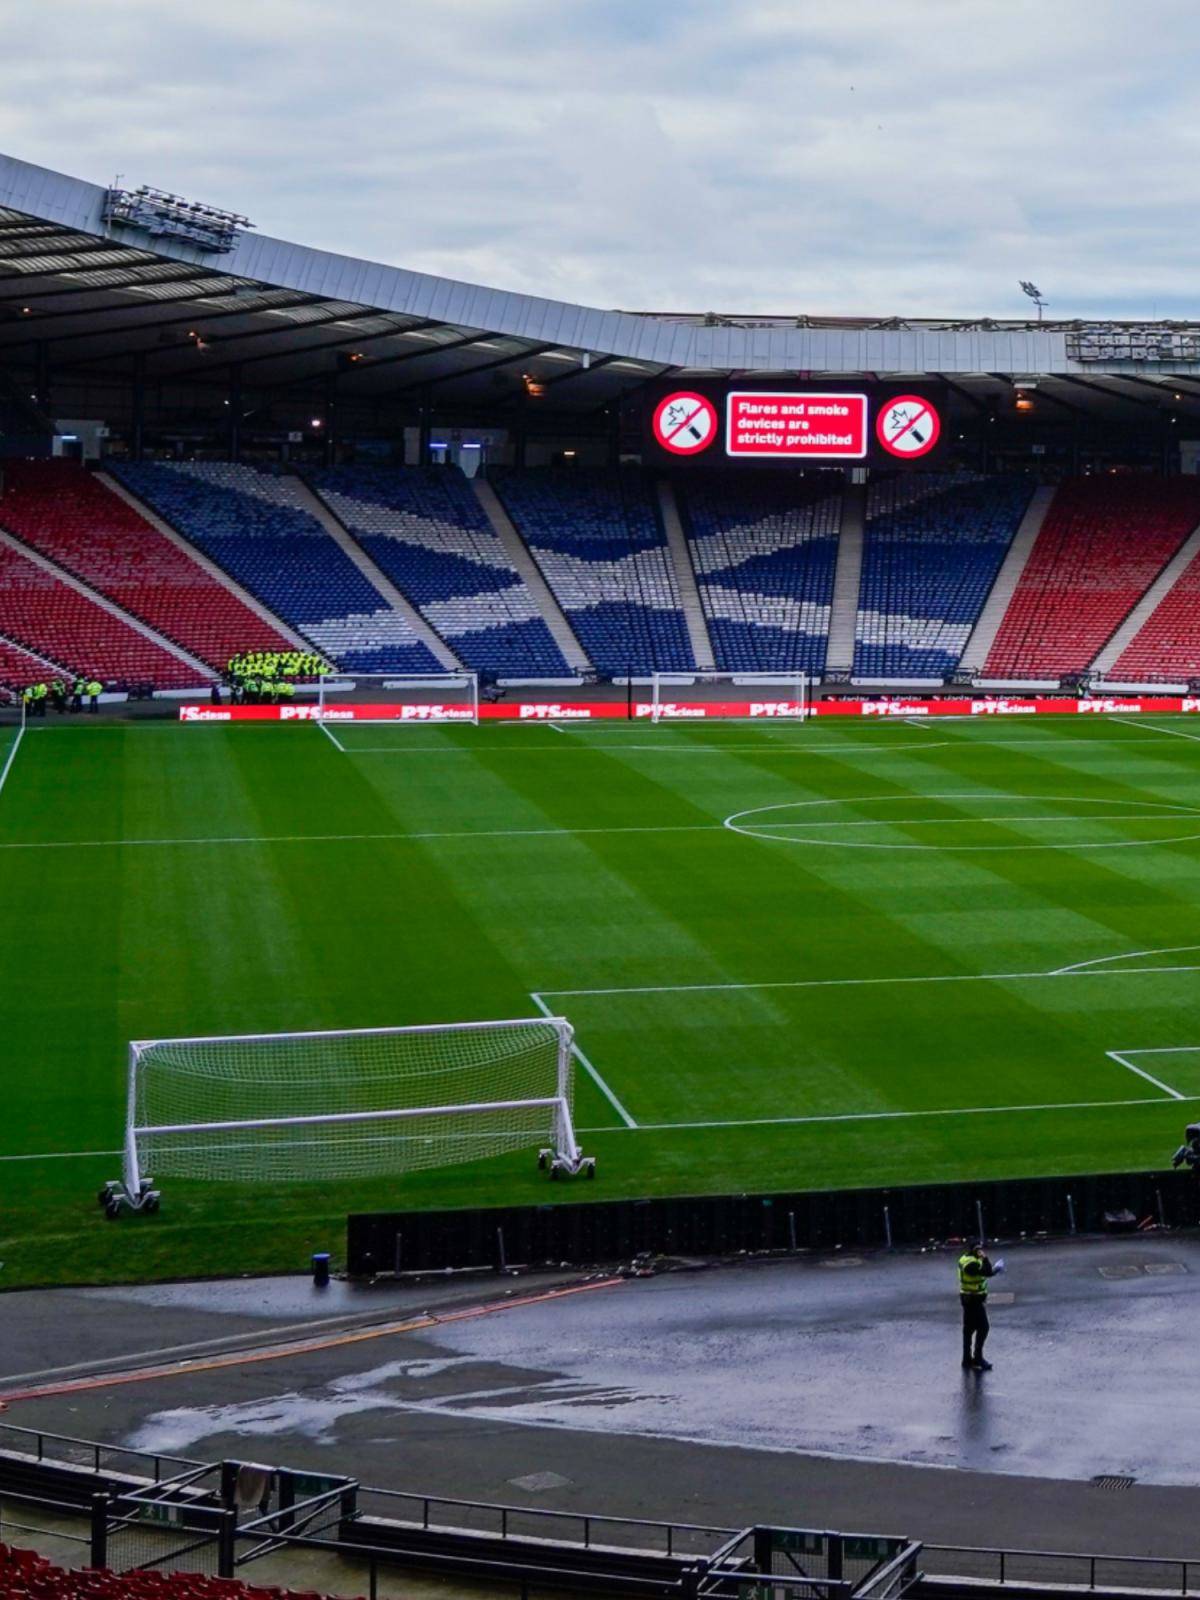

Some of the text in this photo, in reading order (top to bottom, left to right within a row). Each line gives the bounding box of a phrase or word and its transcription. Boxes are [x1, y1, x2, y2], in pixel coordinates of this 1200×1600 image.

[739, 403, 848, 416] Flares and smoke
[737, 417, 809, 430] devices are
[737, 432, 852, 447] strictly prohibited
